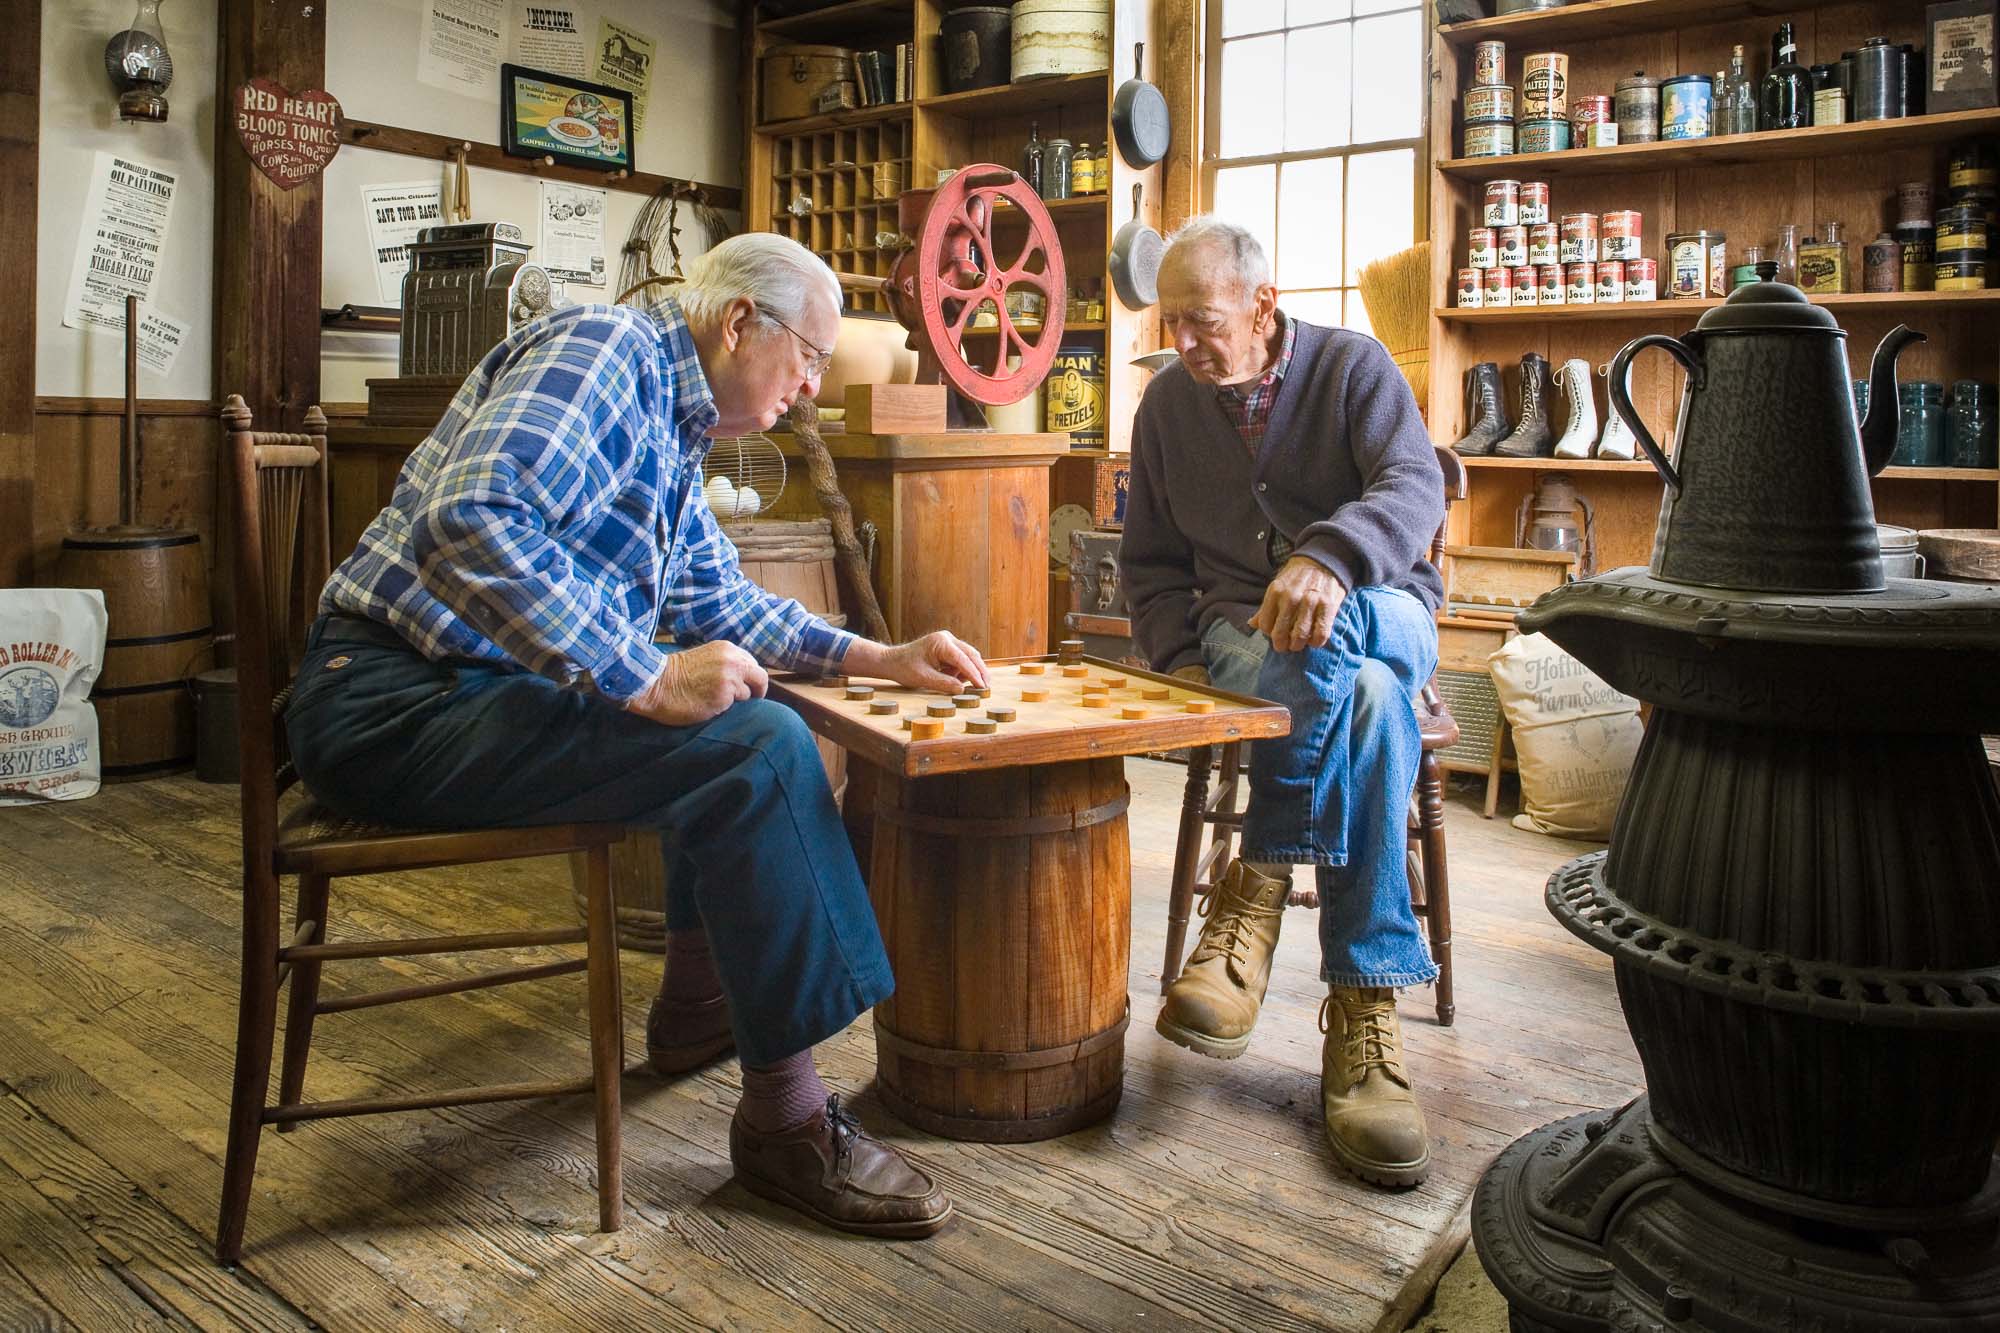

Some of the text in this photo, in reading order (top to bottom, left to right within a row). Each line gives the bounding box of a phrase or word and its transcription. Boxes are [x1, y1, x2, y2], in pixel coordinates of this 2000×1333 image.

[1951, 37, 1976, 49] LIGHT
[243, 85, 339, 126] RED HEART
[238, 112, 339, 146] BLOOD TONICS
[1527, 136, 1550, 145] HOUS
[299, 141, 326, 166] HOGS
[522, 137, 556, 149] CAMPBELL'S
[556, 143, 586, 155] VEGETABLE
[260, 153, 289, 168] COWS
[280, 163, 321, 178] POULTRY
[111, 169, 126, 183] OIL
[127, 174, 173, 198] PAINTINGS
[376, 203, 440, 224] SAVE YOUR RAGS!
[97, 229, 106, 238] AN
[107, 232, 137, 246] AMERICAN
[93, 244, 117, 257] Jane
[120, 251, 155, 268] McCrea
[89, 255, 153, 284] NIAGARA FALLS
[140, 322, 156, 335] HATS
[1054, 399, 1095, 427] PRETZELS
[11, 641, 58, 664] ROLLER
[1534, 681, 1624, 713] Farm Seeds
